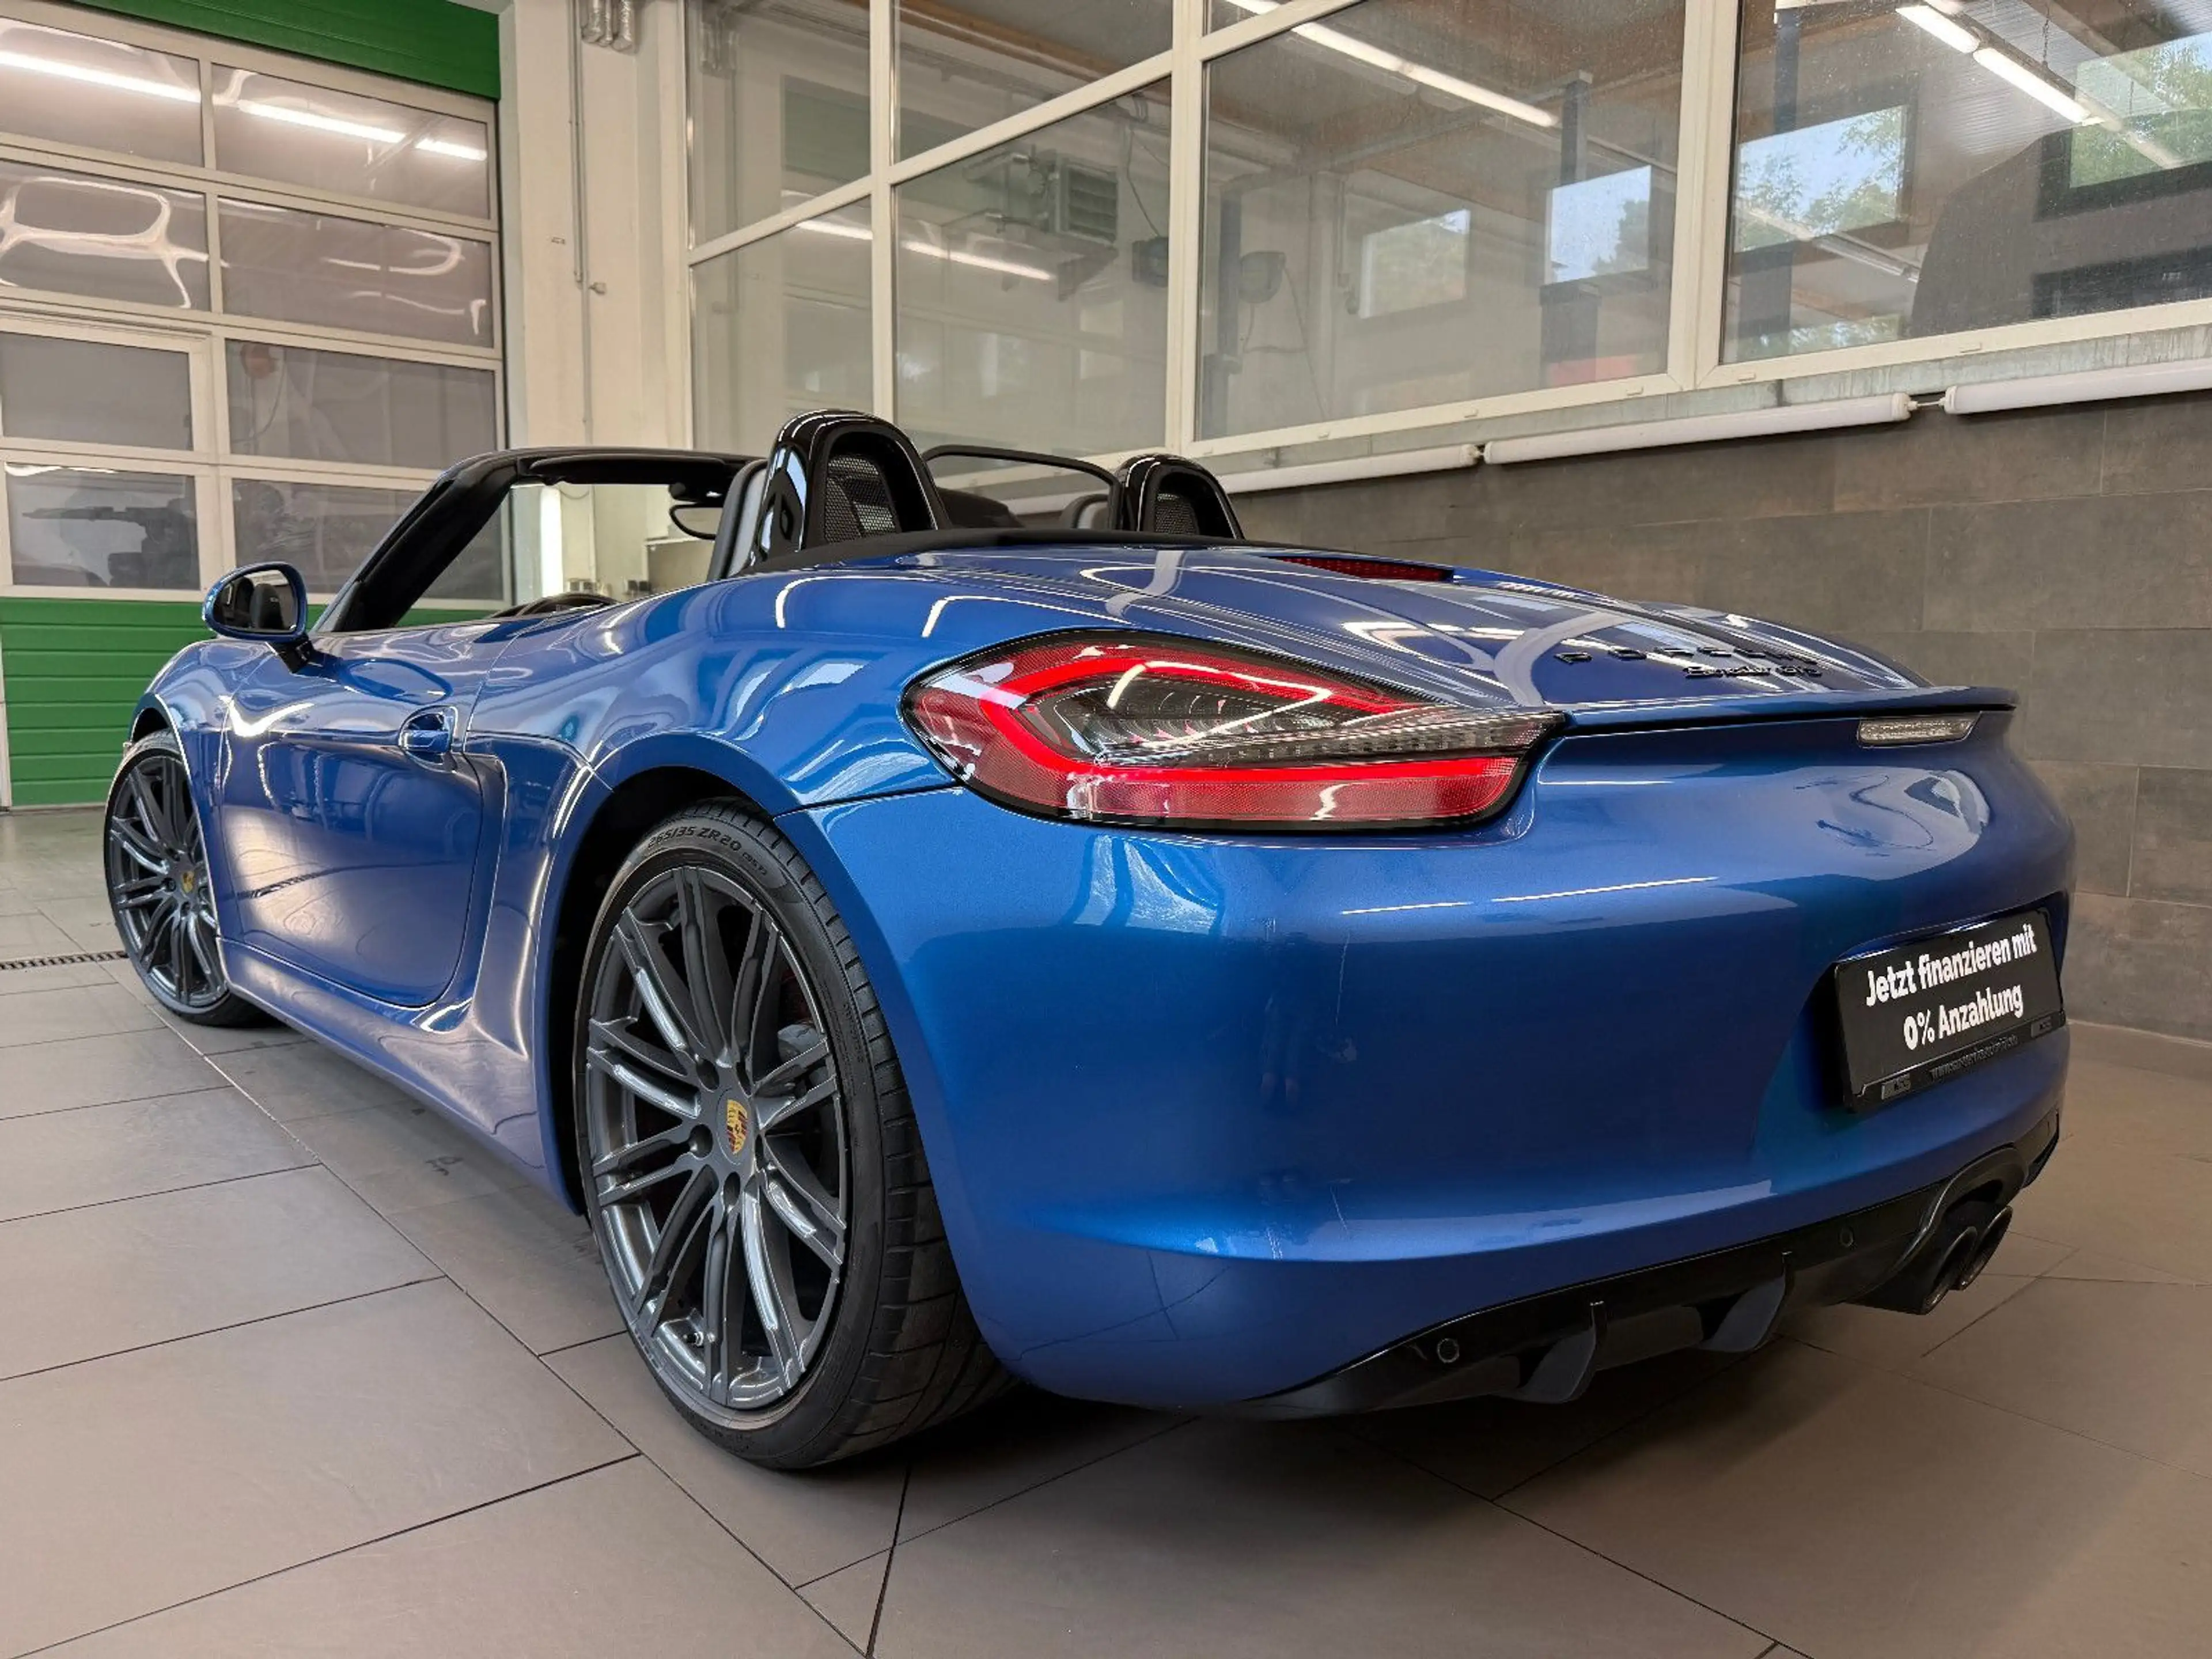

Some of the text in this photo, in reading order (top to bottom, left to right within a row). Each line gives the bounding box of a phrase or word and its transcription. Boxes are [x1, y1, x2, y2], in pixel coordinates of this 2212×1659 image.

[1866, 923, 2037, 1006] Jetzt finanzieren mit
[1903, 984, 2024, 1050] 0% Anzahlung
